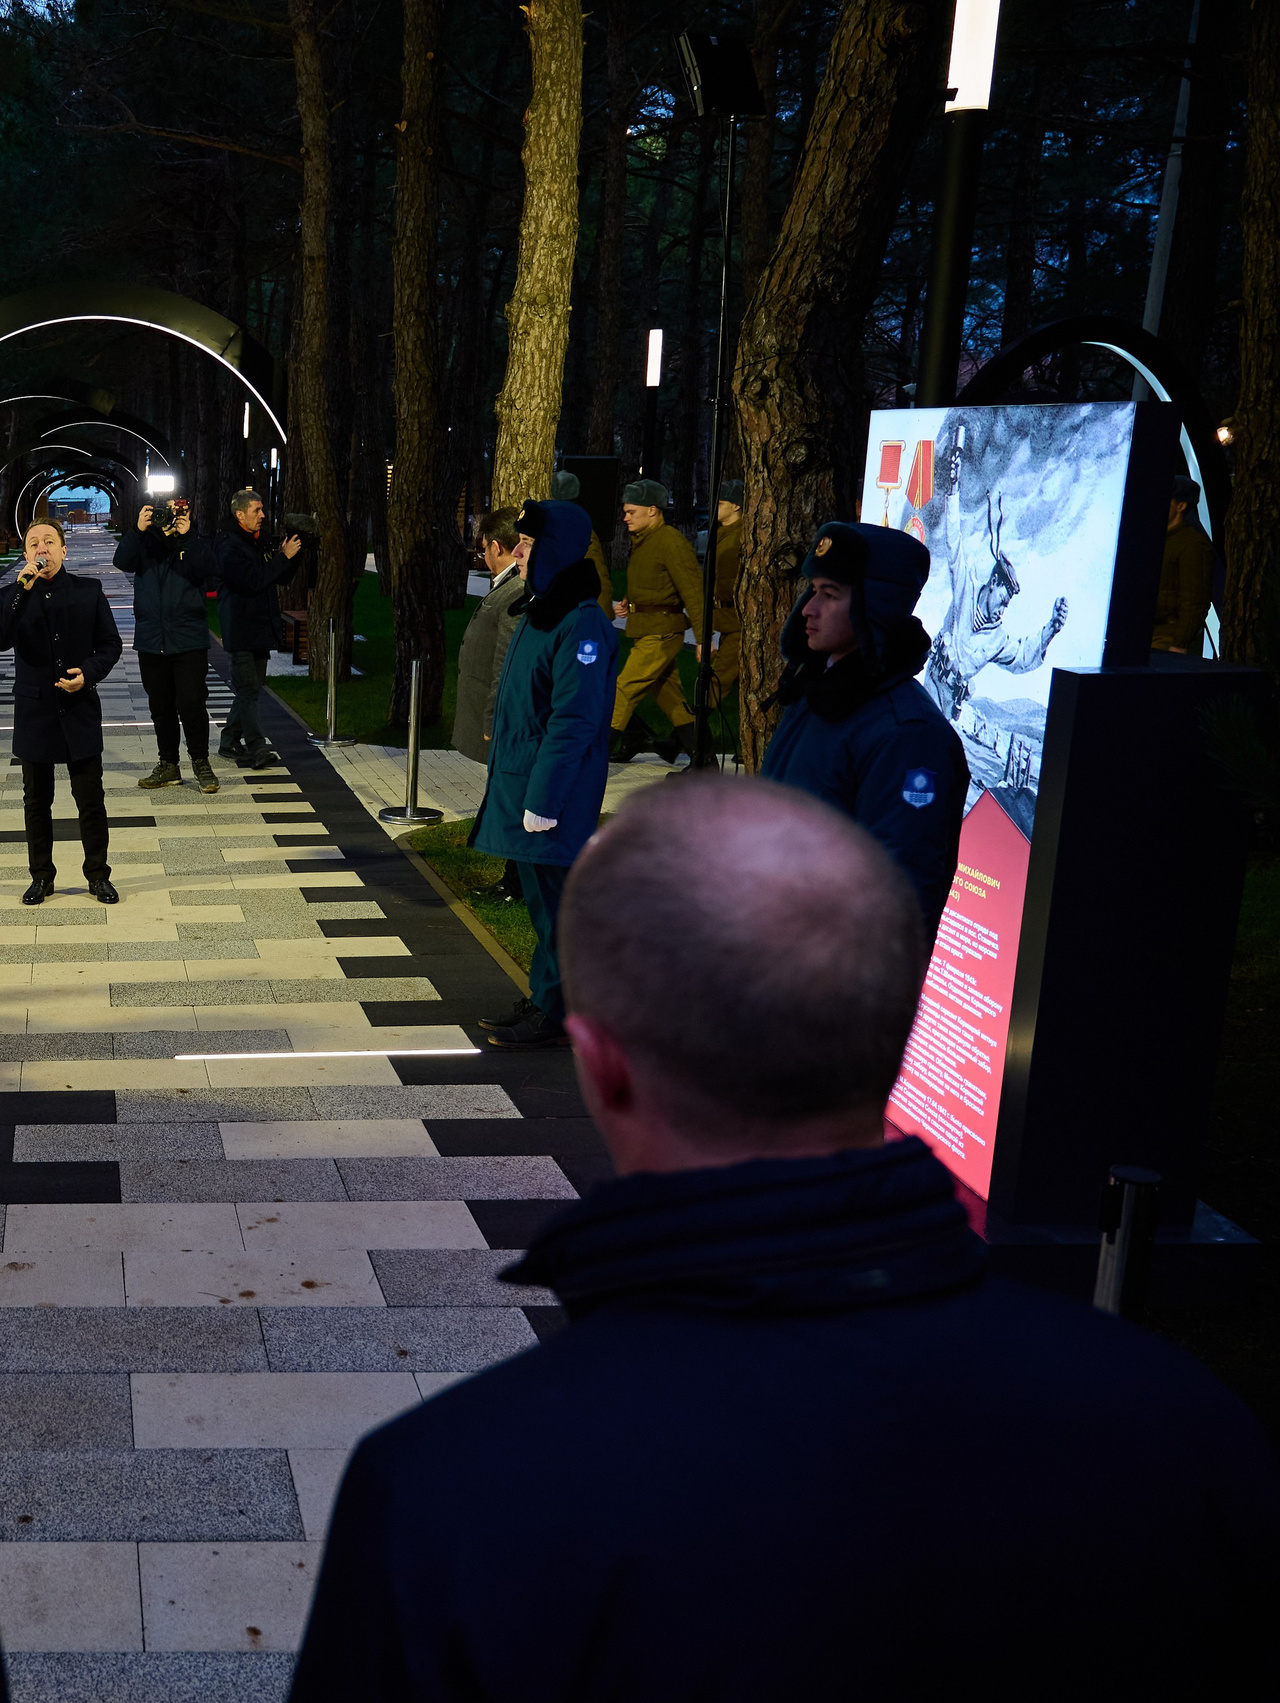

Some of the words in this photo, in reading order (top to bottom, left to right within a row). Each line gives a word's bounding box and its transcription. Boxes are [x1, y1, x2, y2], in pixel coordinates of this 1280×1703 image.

[957, 862, 1001, 890] МИХАЙЛОВИЧ
[964, 881, 987, 899] СОЮЗА
[937, 930, 961, 948] ужественно
[972, 922, 989, 935] отряда
[988, 930, 998, 941] под
[942, 959, 946, 967] 7
[945, 962, 965, 978] февраля
[983, 996, 1003, 1013] оборону
[971, 1046, 990, 1063] обратно.
[977, 1059, 992, 1074] забор,
[903, 1087, 925, 1108] Советского
[924, 1103, 938, 1119] Союза
[963, 1096, 984, 1116] бросился
[950, 1114, 962, 1128] было
[961, 1124, 985, 1146] присвоено
[951, 1144, 965, 1159] флота.
